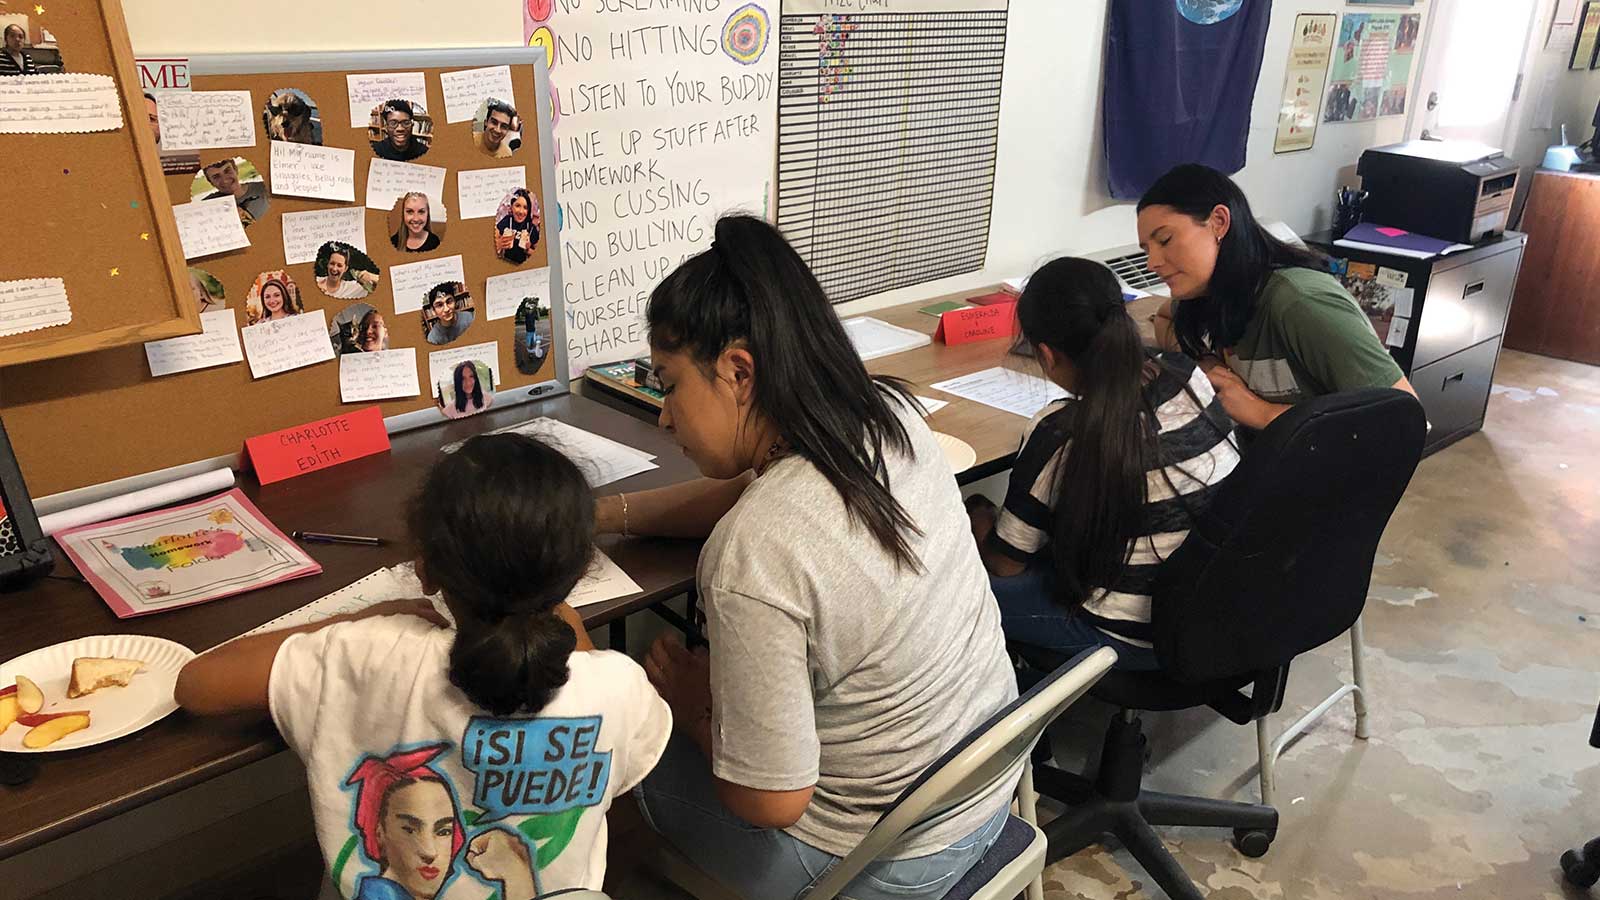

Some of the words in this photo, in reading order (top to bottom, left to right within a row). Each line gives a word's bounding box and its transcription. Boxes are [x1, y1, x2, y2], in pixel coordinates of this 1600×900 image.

[557, 32, 593, 65] NO
[609, 25, 718, 61] HITTING
[556, 81, 626, 117] LISTEN
[636, 78, 656, 107] TO
[665, 70, 712, 107] YOUR
[720, 71, 774, 106] BUDDY
[557, 130, 604, 163] LINE
[620, 130, 642, 156] UP
[653, 121, 708, 152] STUFF
[713, 114, 760, 144] AFTER
[561, 158, 665, 194] HOMEWORK
[565, 200, 598, 231] NO
[613, 179, 710, 219] CUSSING
[565, 241, 598, 270] NO
[607, 215, 704, 258] BULLYING
[564, 264, 635, 305] CLEAN
[643, 255, 671, 282] UP
[565, 290, 648, 331] YOURSELF
[567, 322, 641, 360] SHARE
[279, 418, 351, 447] CHARLOTTE
[296, 447, 342, 471] EDITH
[149, 540, 213, 558] Homework
[166, 554, 226, 573] Folder
[544, 725, 596, 763] SE
[481, 760, 604, 807] PUEDE!
